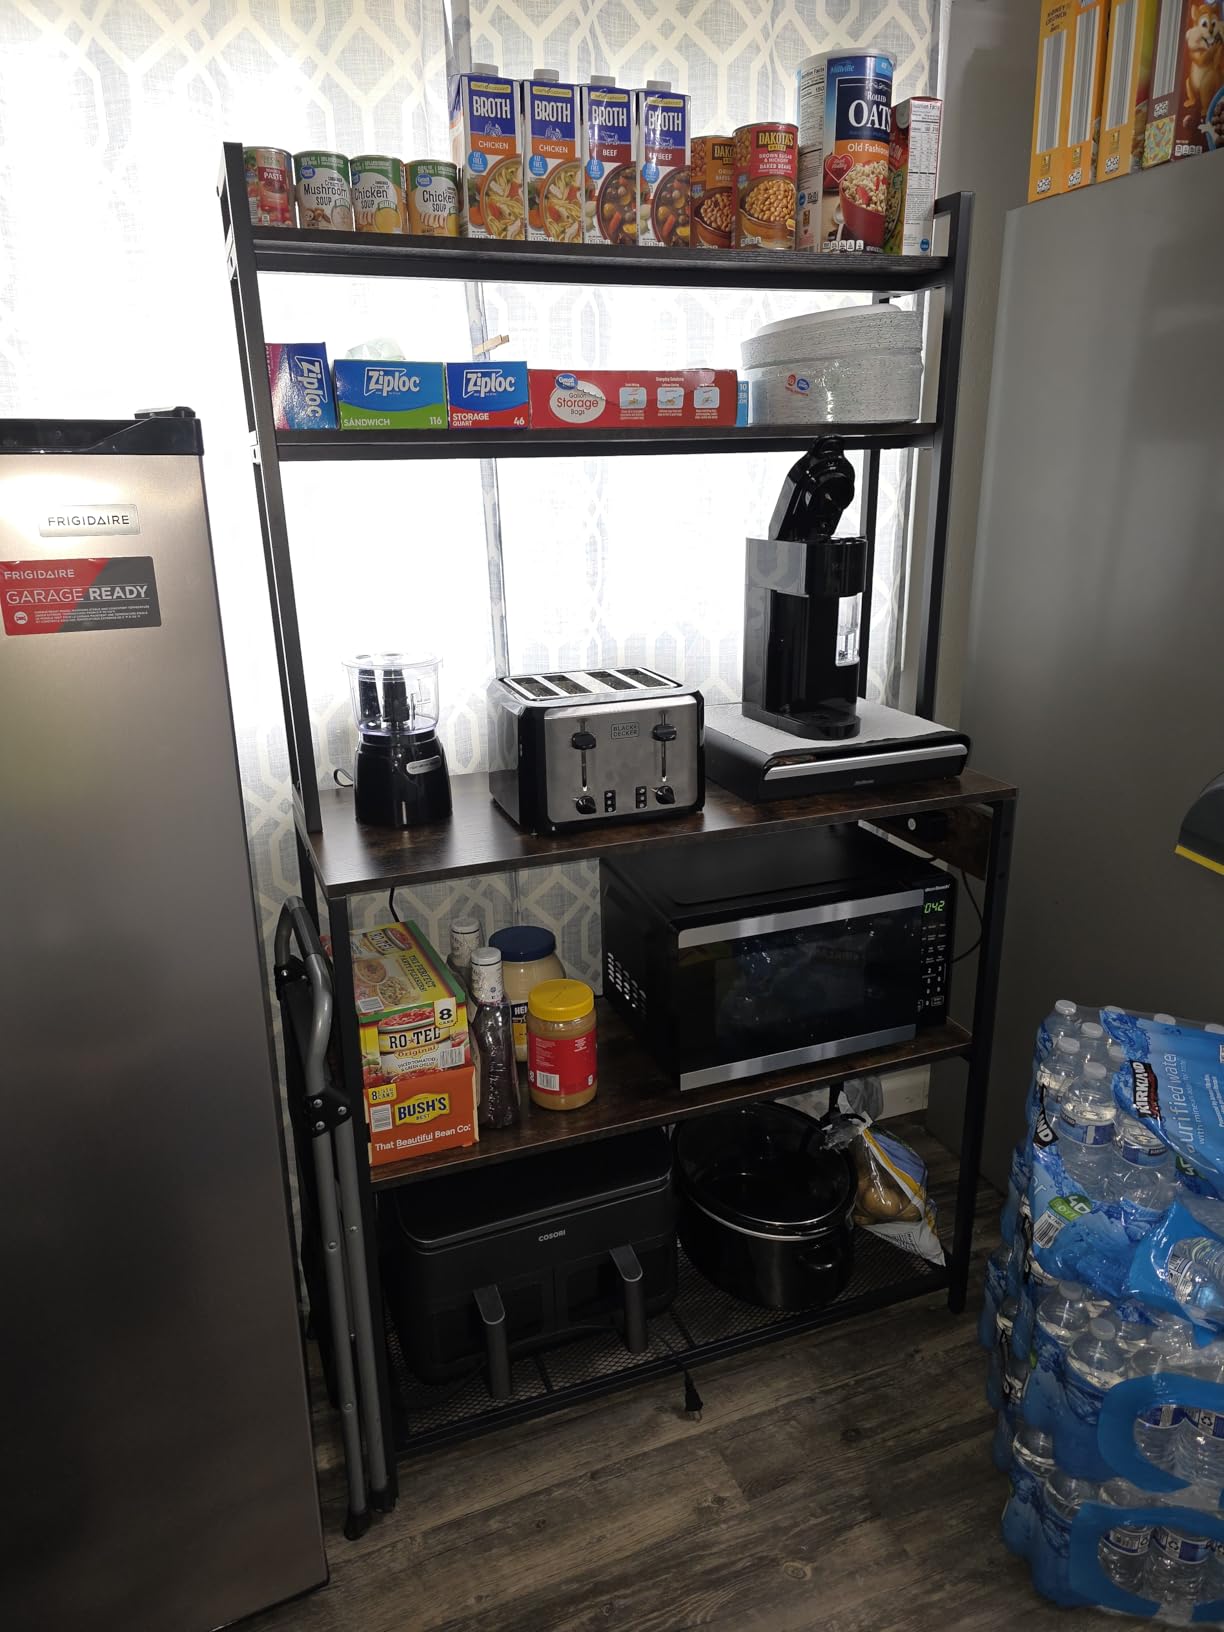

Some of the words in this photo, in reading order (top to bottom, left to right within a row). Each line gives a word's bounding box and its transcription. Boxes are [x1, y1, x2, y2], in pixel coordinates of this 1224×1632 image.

[472, 95, 511, 119] BROTH
[534, 100, 571, 123] BROTH
[591, 105, 627, 127] BROTH
[648, 110, 682, 132] BROTH
[478, 140, 509, 149] CHICKEN
[538, 144, 568, 153] CHICKEN
[847, 142, 863, 152] Old
[657, 153, 673, 161] BEEF
[263, 172, 283, 181] PASTE
[303, 183, 348, 198] Mushroom
[354, 185, 388, 199] Chicken
[422, 189, 456, 203] Chicken
[315, 196, 332, 206] SOUP
[360, 200, 375, 209] SOUP
[431, 203, 447, 212] SOUP
[297, 361, 322, 417] Ziploc
[368, 370, 421, 397] Ziploc
[466, 372, 516, 398] Ziploc
[556, 397, 599, 411] Storage
[452, 412, 490, 421] STORAGE
[570, 408, 585, 416] Bags
[343, 418, 391, 427] SANDWICH
[429, 416, 442, 425] 116
[513, 416, 525, 426] 46
[47, 514, 130, 526] FRIGIDAIRE
[3, 568, 75, 580] FRIGIDAIRE
[6, 588, 85, 605] GARAGE
[88, 585, 149, 601] READY
[439, 1008, 452, 1020] 8
[397, 1044, 437, 1057] Original
[1132, 1061, 1151, 1115] KIRKLAND
[371, 1090, 378, 1101] 8
[397, 1096, 448, 1122] BUSH'S
[415, 1113, 430, 1121] BEST
[375, 1141, 396, 1152] That
[396, 1131, 434, 1148] Beautiful
[434, 1127, 456, 1139] Bean
[537, 1229, 566, 1242] COSORI
